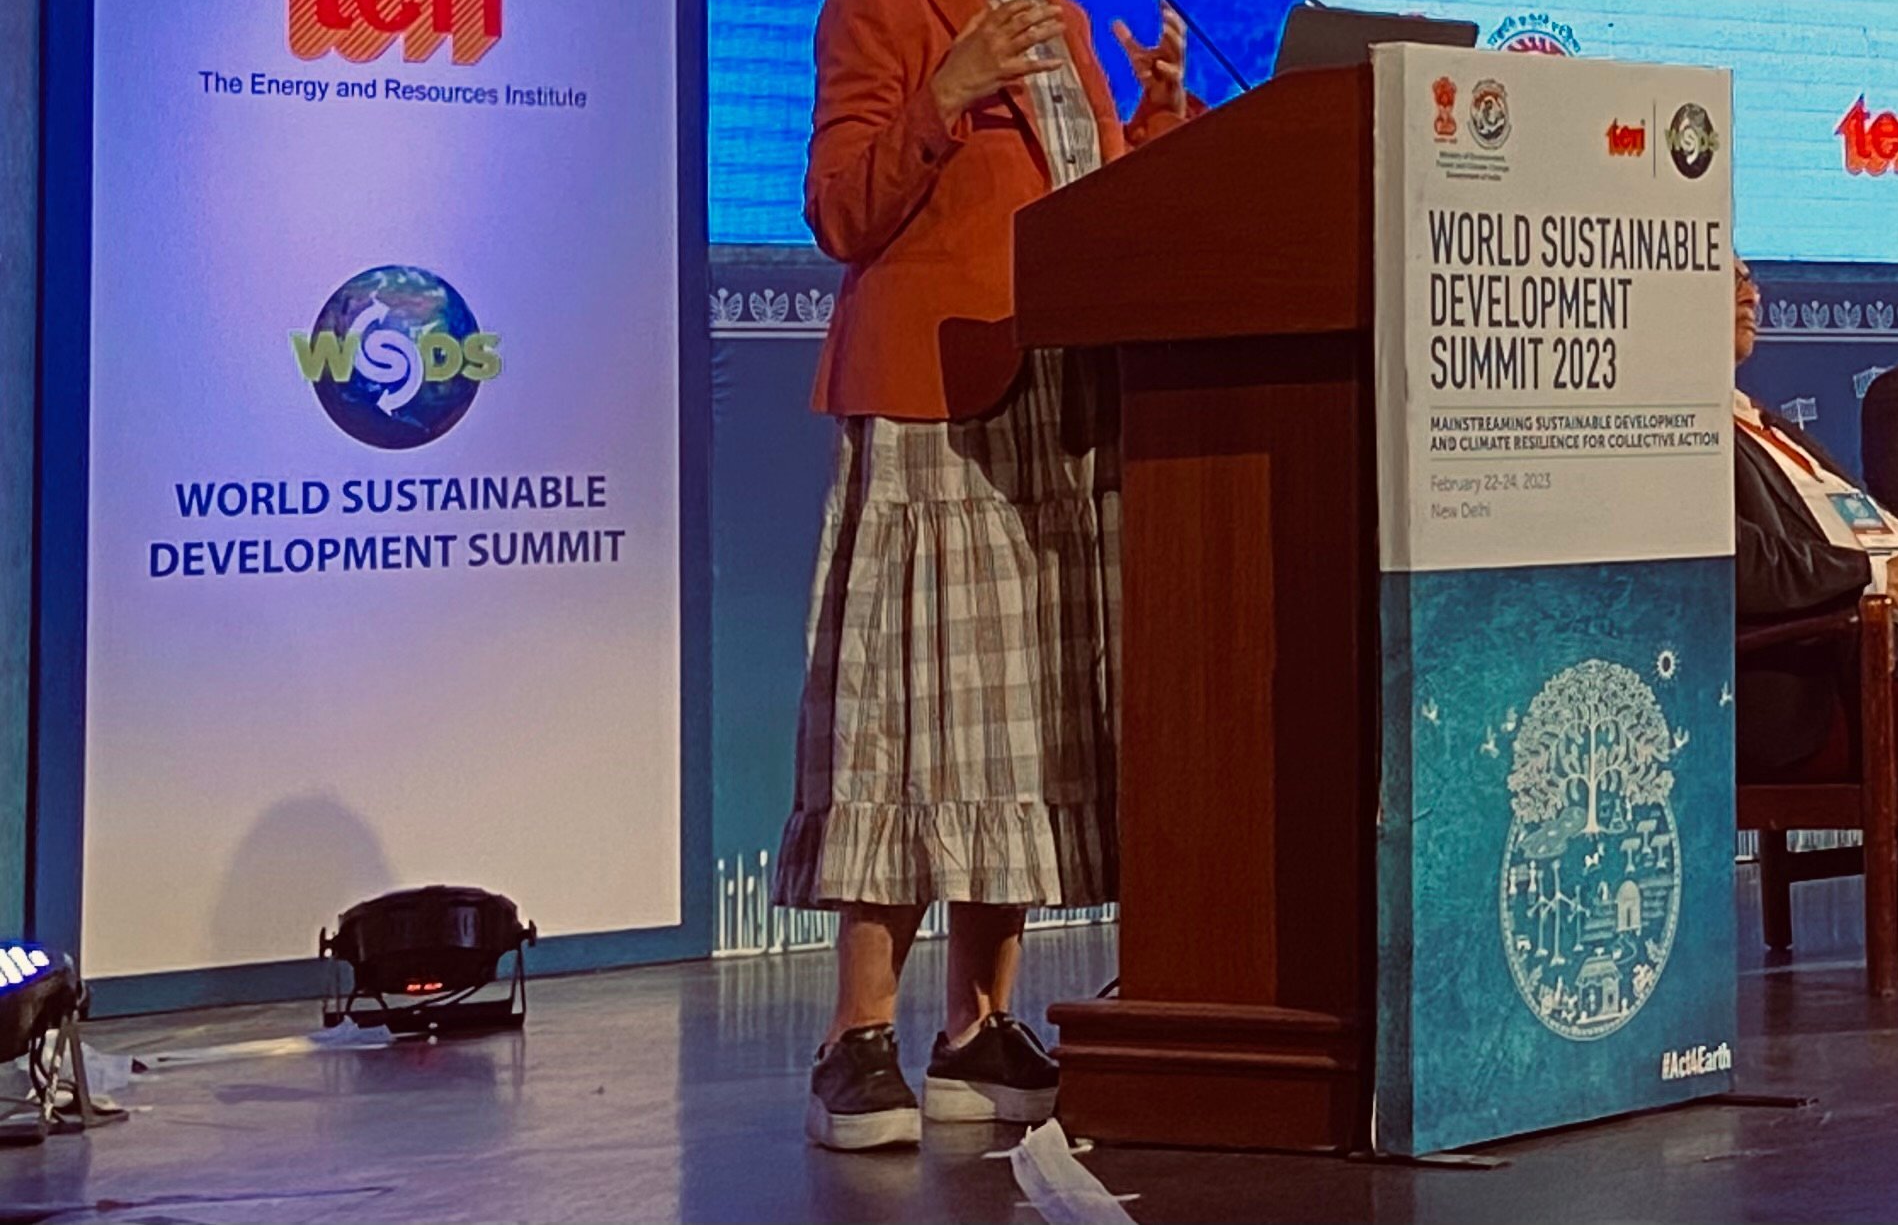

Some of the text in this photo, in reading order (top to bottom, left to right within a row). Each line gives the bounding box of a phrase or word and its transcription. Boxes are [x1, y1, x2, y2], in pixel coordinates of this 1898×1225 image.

[199, 71, 587, 109] The Energy and Resources Institute
[1605, 118, 1646, 157] teri
[1429, 210, 1721, 271] WORLD SUSTAINABLE
[1431, 274, 1632, 329] DEVELOPMENT
[290, 329, 502, 383] WSDS
[1430, 335, 1617, 390] SUMMIT 2023
[1430, 414, 1695, 431] MAINSTREAMING SUSTAINABLE DEVELOPMENT
[1430, 431, 1719, 451] AND CLIMATE RESILIENCE FOR COLLECTIVE ACTION
[175, 475, 607, 518] WORLD SUSTAINABLE
[1430, 474, 1481, 494] February
[149, 530, 625, 578] DEVELOPMENT SUMMIT
[1661, 1041, 1732, 1081] #Act4Earth
